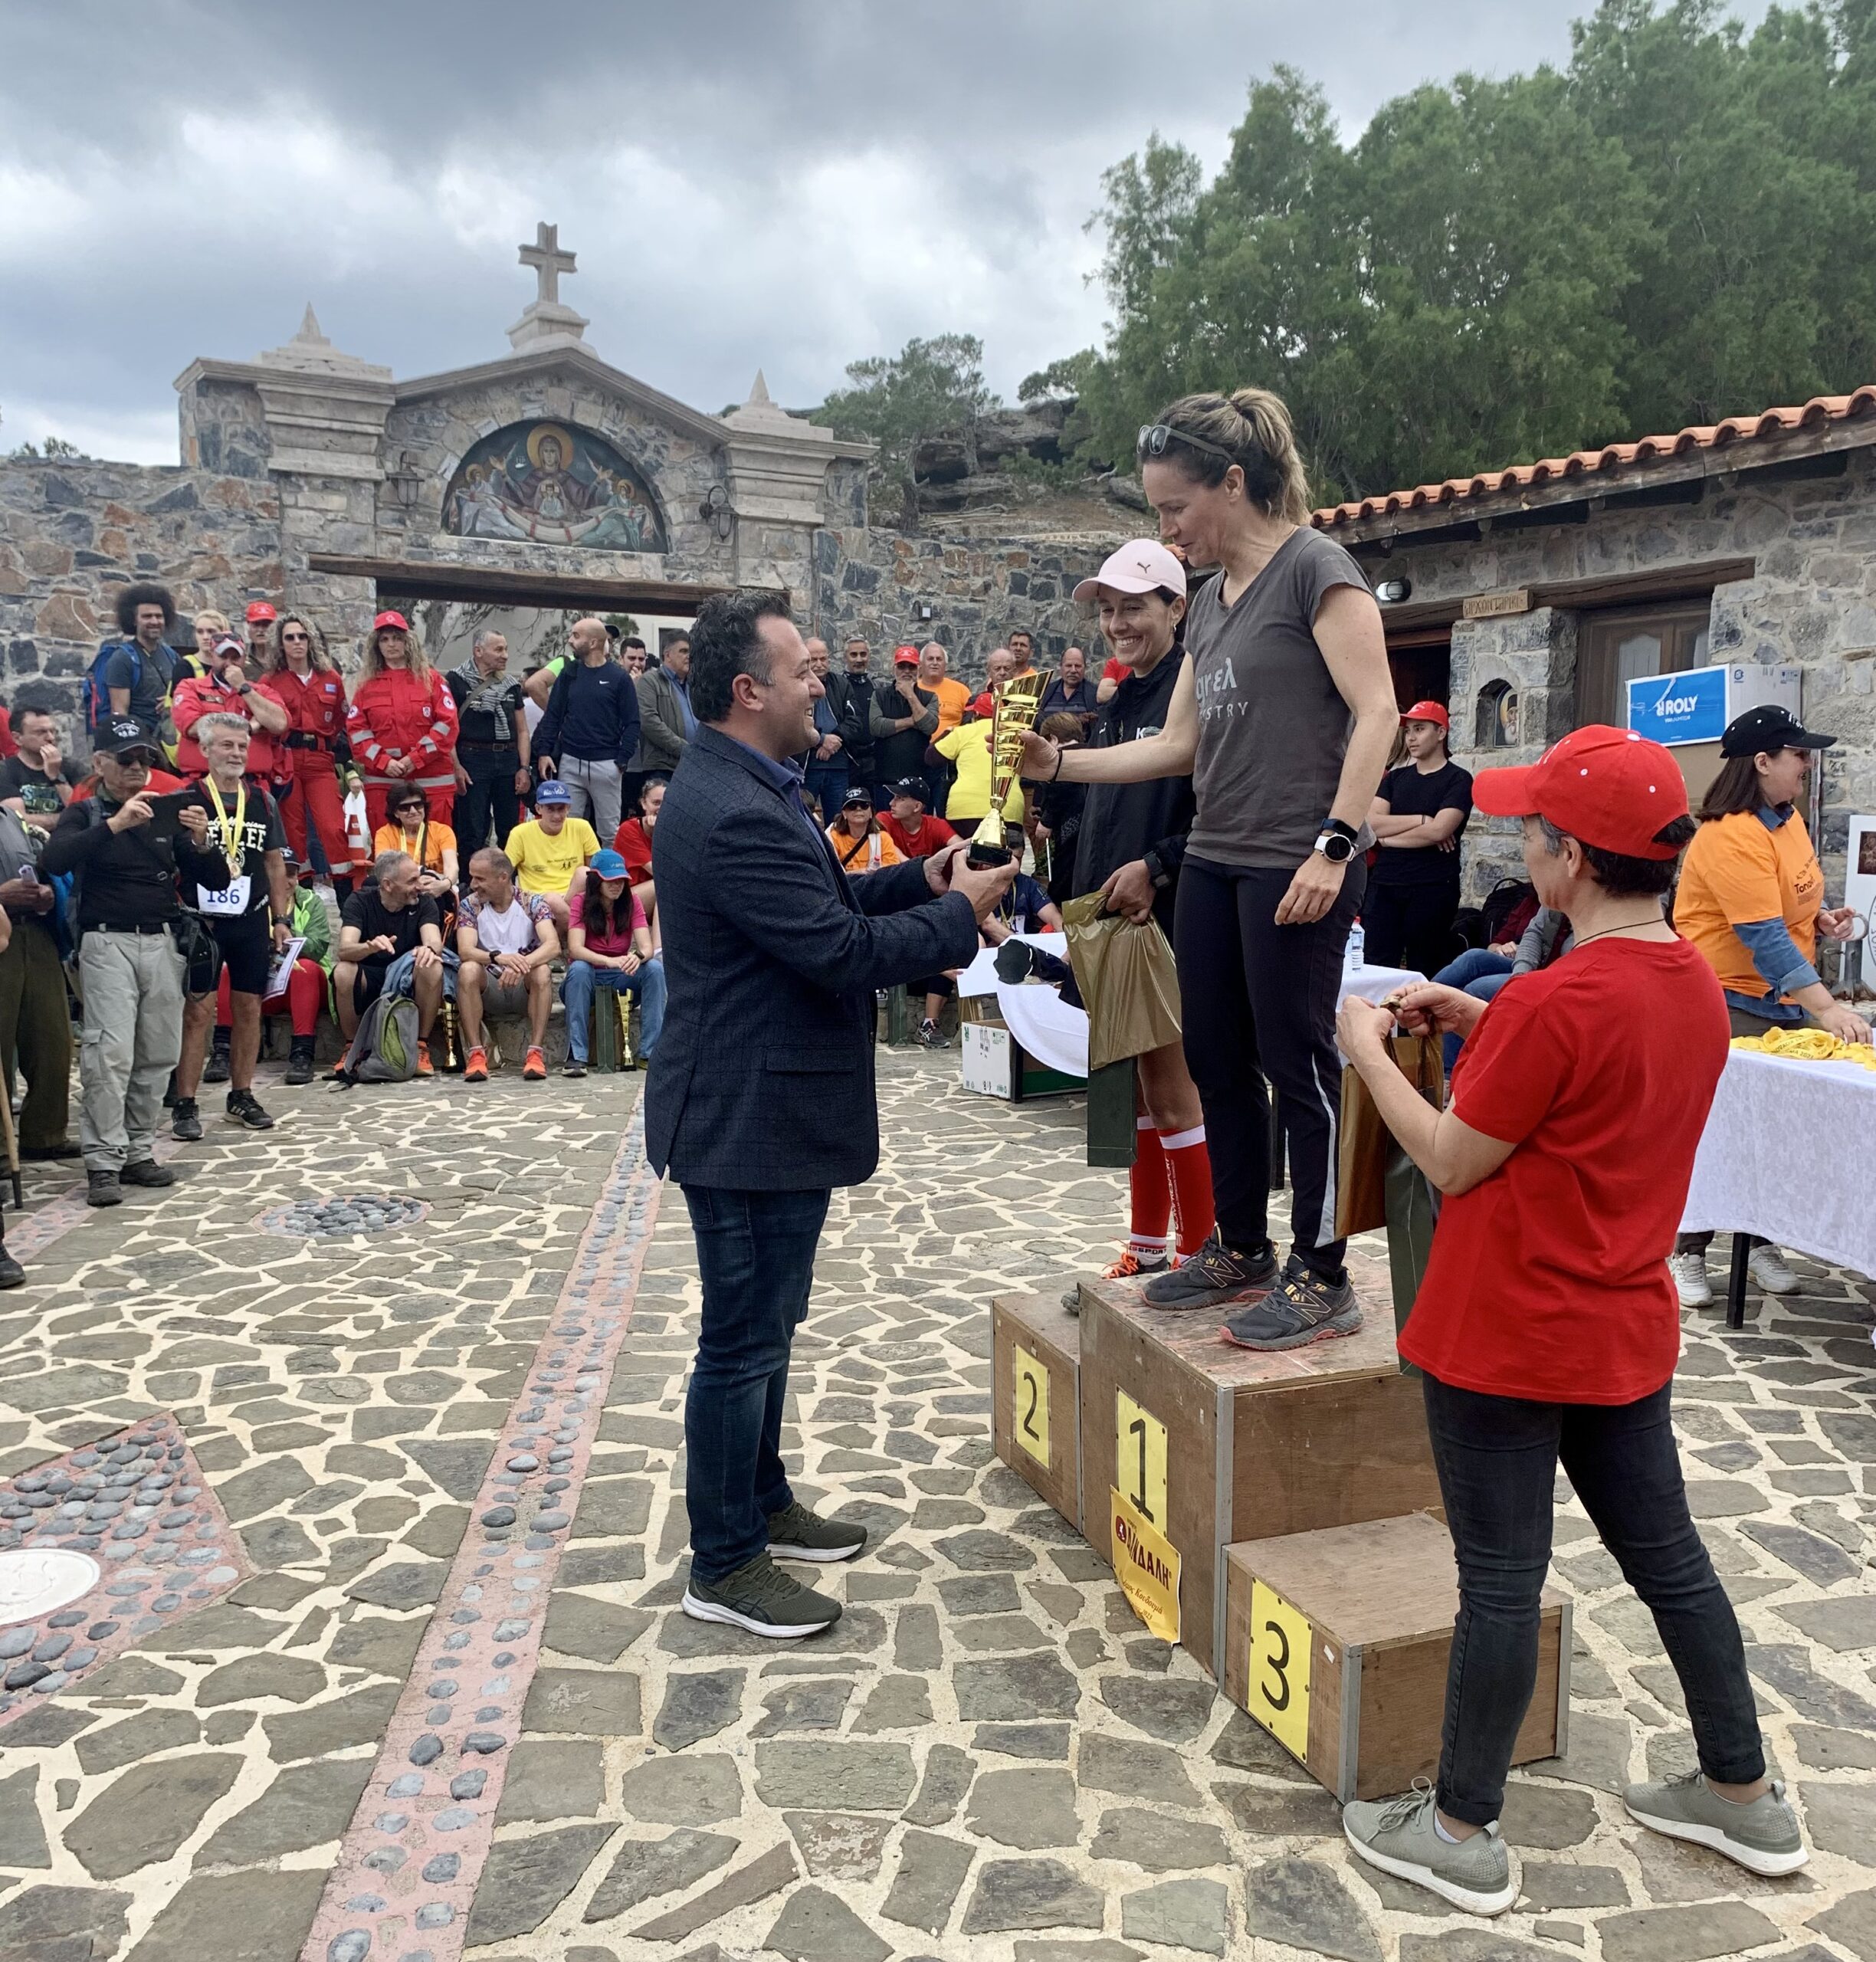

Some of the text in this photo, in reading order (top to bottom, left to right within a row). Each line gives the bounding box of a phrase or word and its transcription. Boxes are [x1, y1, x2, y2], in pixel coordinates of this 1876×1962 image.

[207, 889, 240, 904] 186
[1024, 1371, 1040, 1442] 2
[1130, 1418, 1155, 1524] 1
[1261, 1620, 1290, 1711] 3
